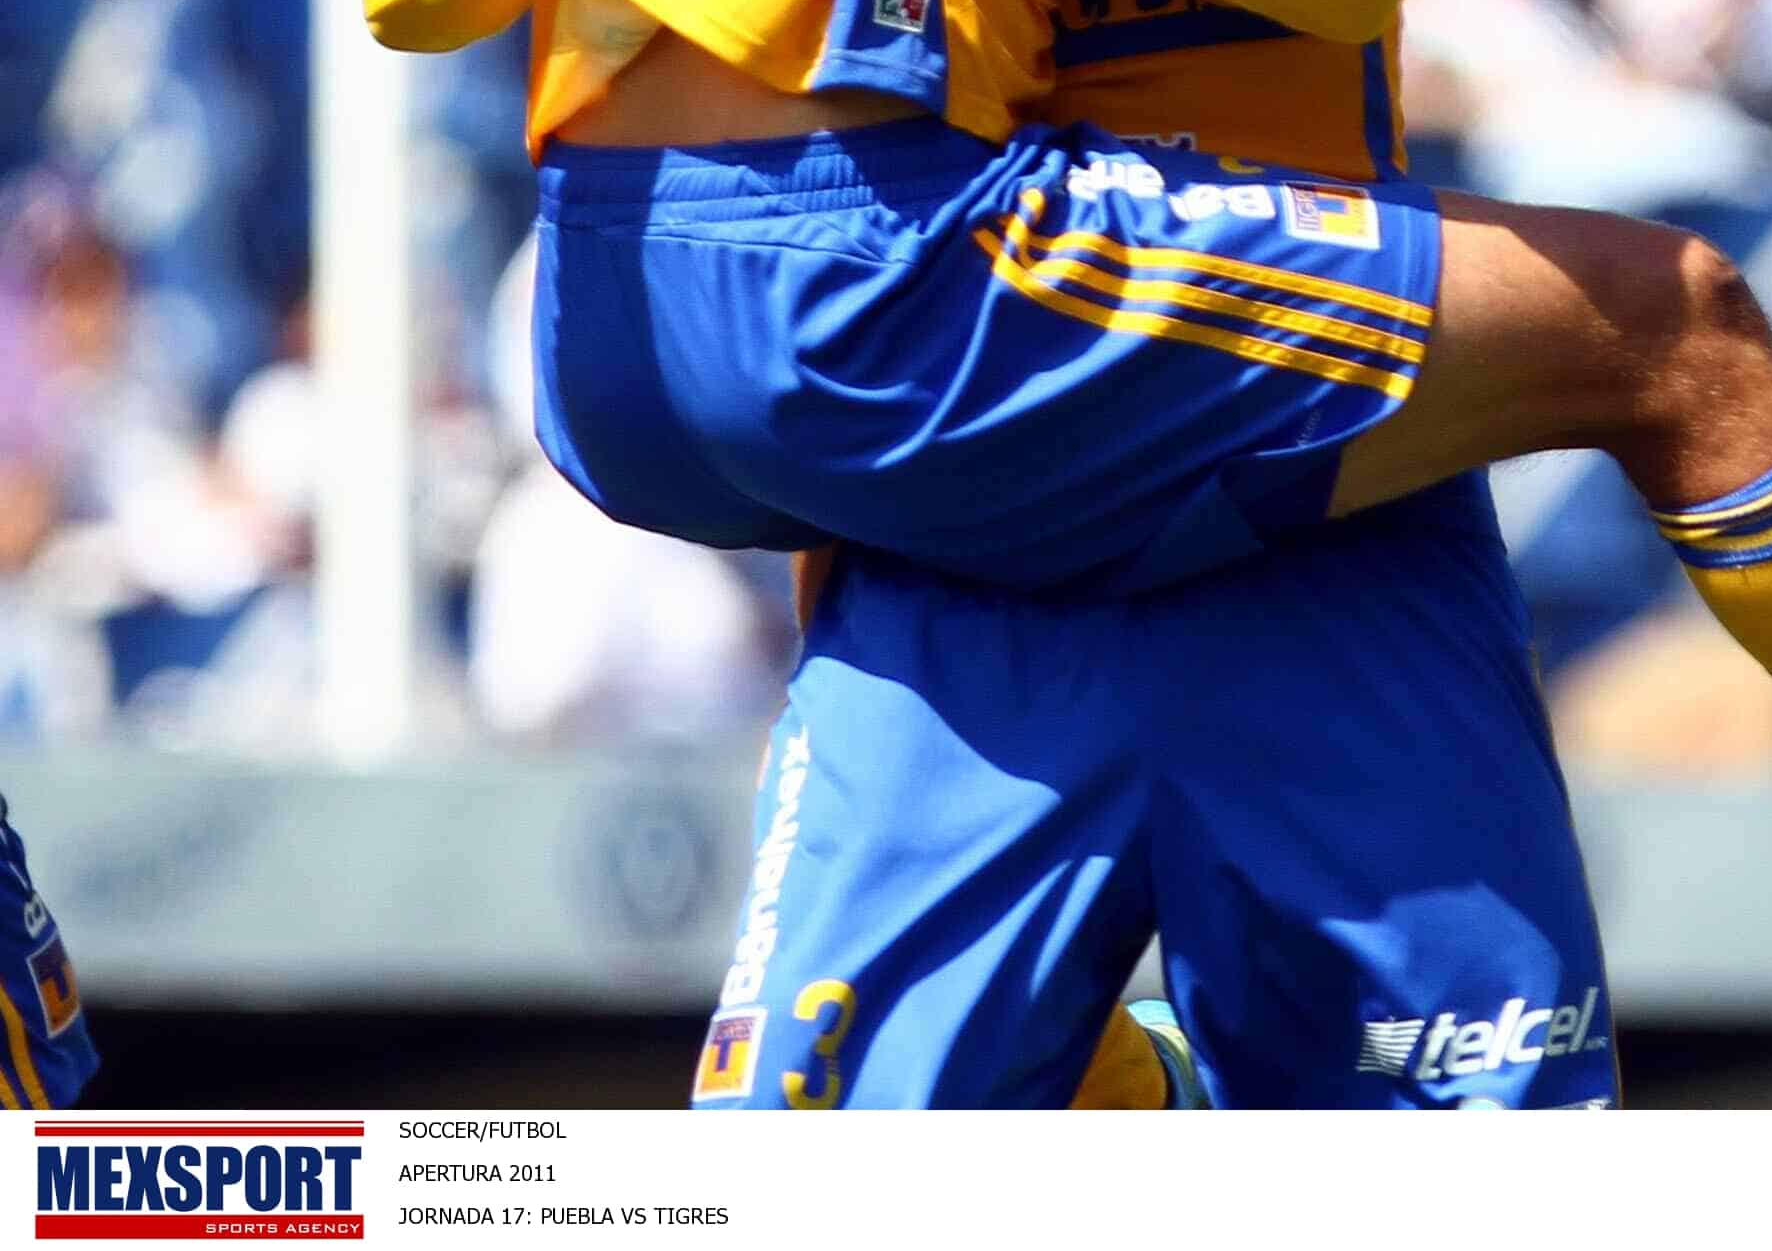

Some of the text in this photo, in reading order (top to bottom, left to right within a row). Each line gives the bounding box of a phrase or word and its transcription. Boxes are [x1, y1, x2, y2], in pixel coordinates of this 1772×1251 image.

[718, 723, 809, 1007] Banamex
[782, 978, 857, 1110] 3
[1414, 986, 1599, 1081] telcel
